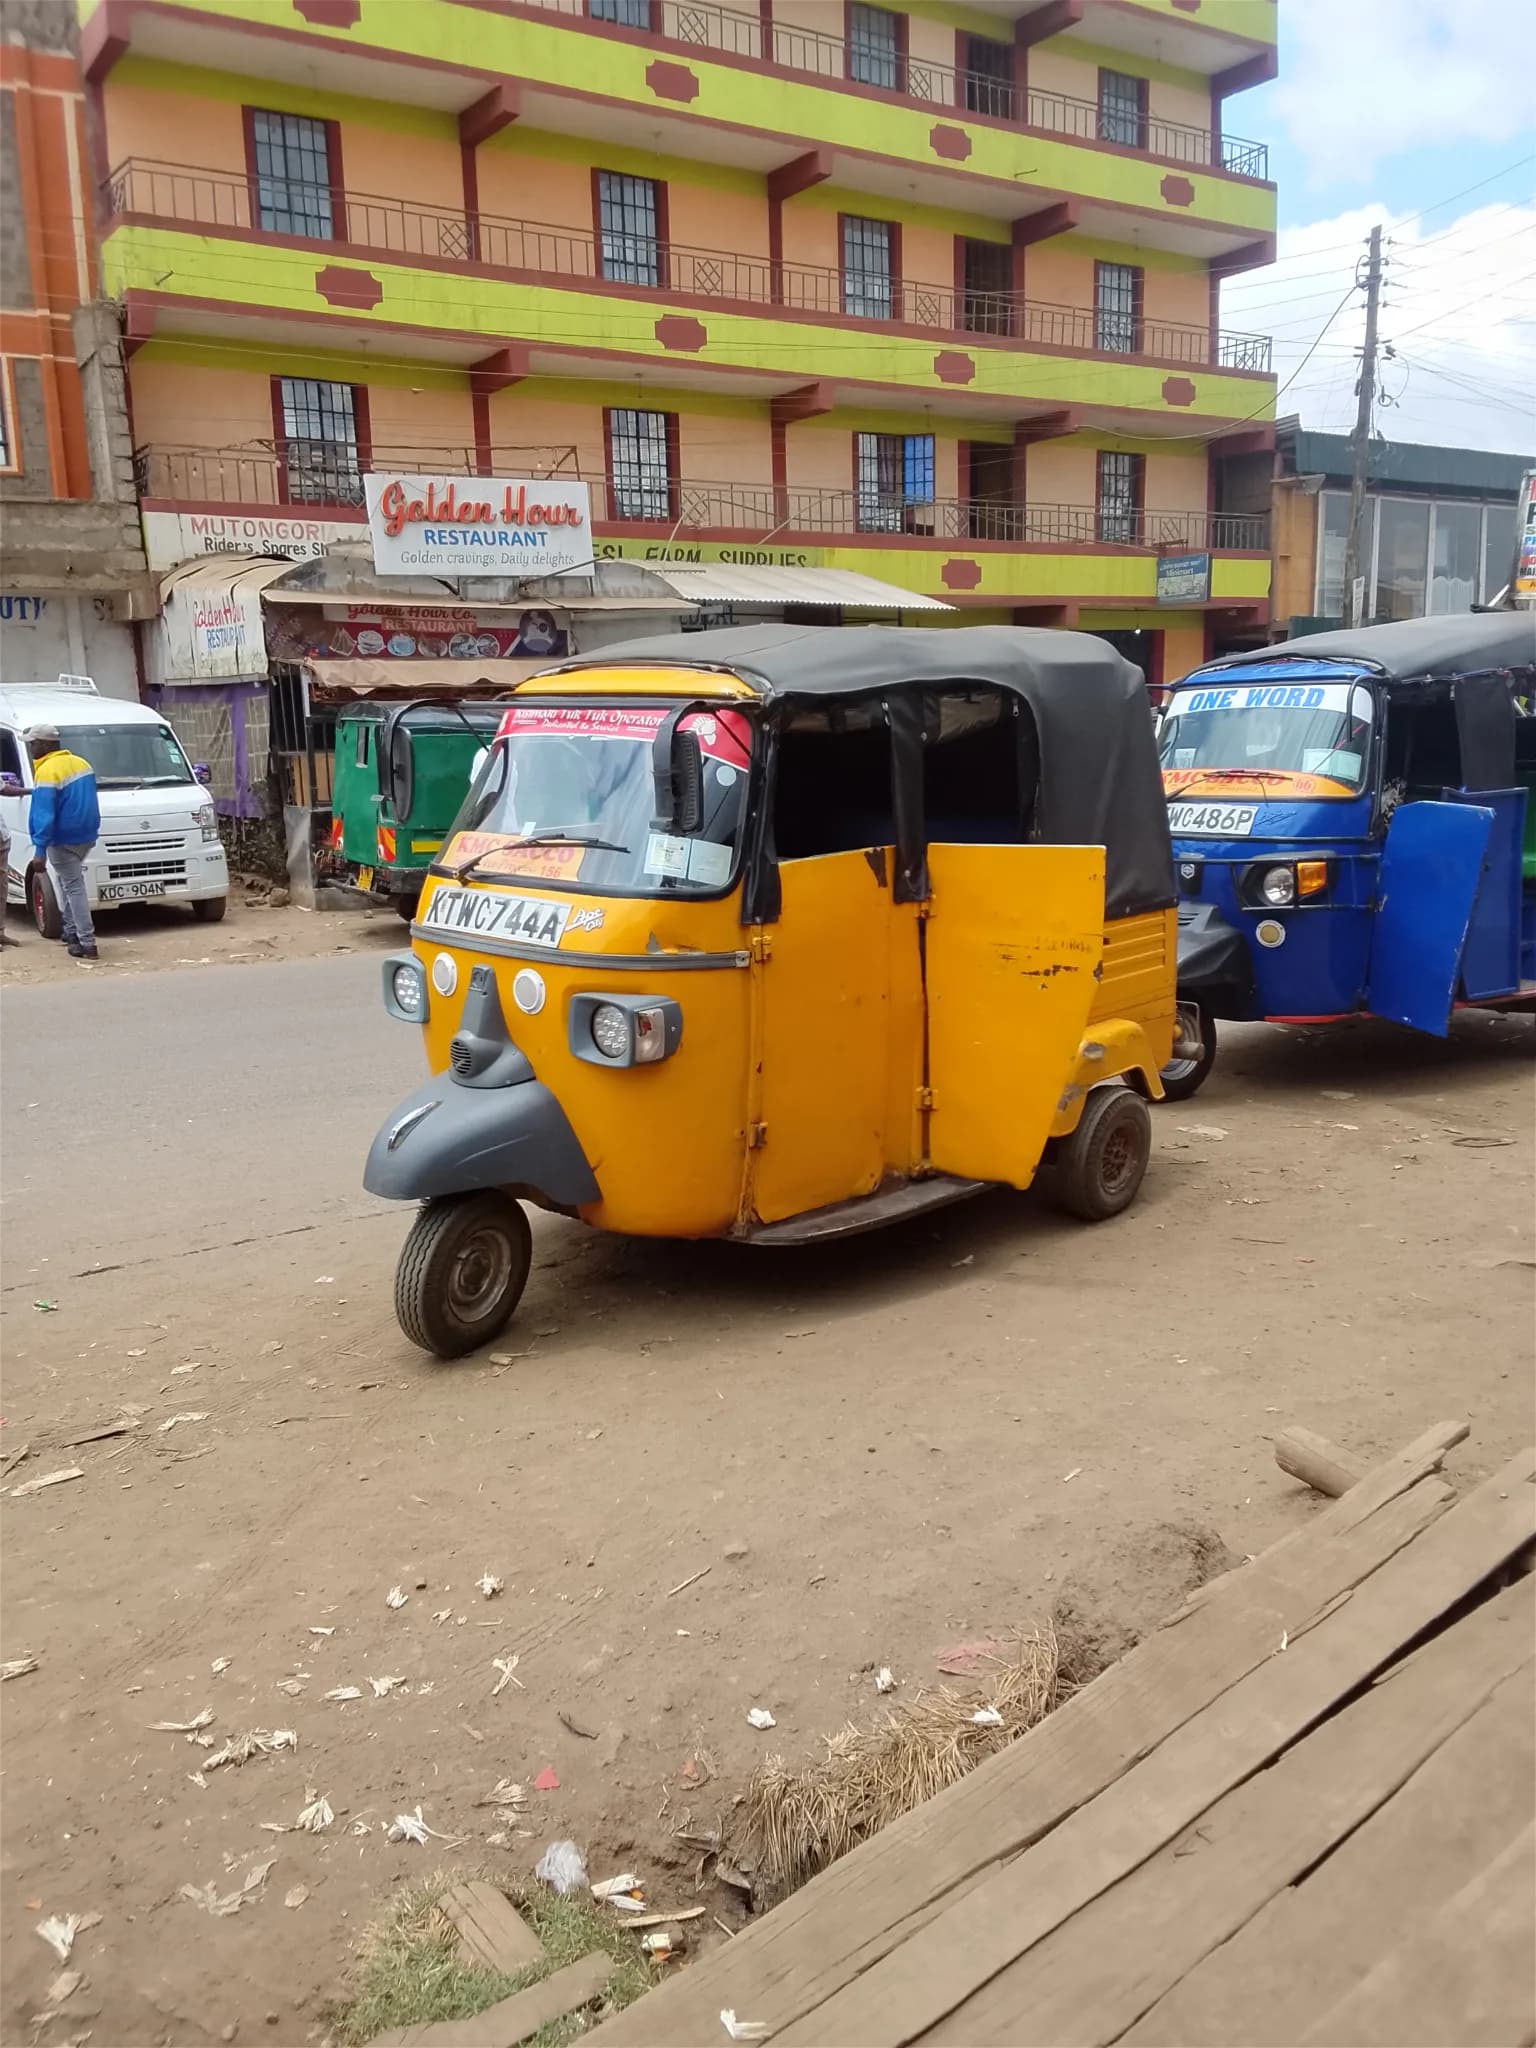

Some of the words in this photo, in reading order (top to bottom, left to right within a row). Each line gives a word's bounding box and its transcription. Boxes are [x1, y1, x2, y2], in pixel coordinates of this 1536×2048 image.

[380, 481, 497, 537] Golden
[500, 485, 583, 527] Hour
[424, 529, 548, 547] RESTAURANT
[262, 539, 307, 556] Spares
[400, 550, 444, 565] Golden
[500, 552, 530, 567] Daily
[532, 552, 575, 568] delights
[383, 618, 475, 632] RESTAURANT
[1187, 689, 1239, 712] ONE
[1245, 686, 1326, 708] WORD
[1168, 806, 1254, 831] WC486P
[99, 886, 125, 900] KDC
[131, 882, 164, 896] 904N
[426, 889, 561, 942] KTWC744A
